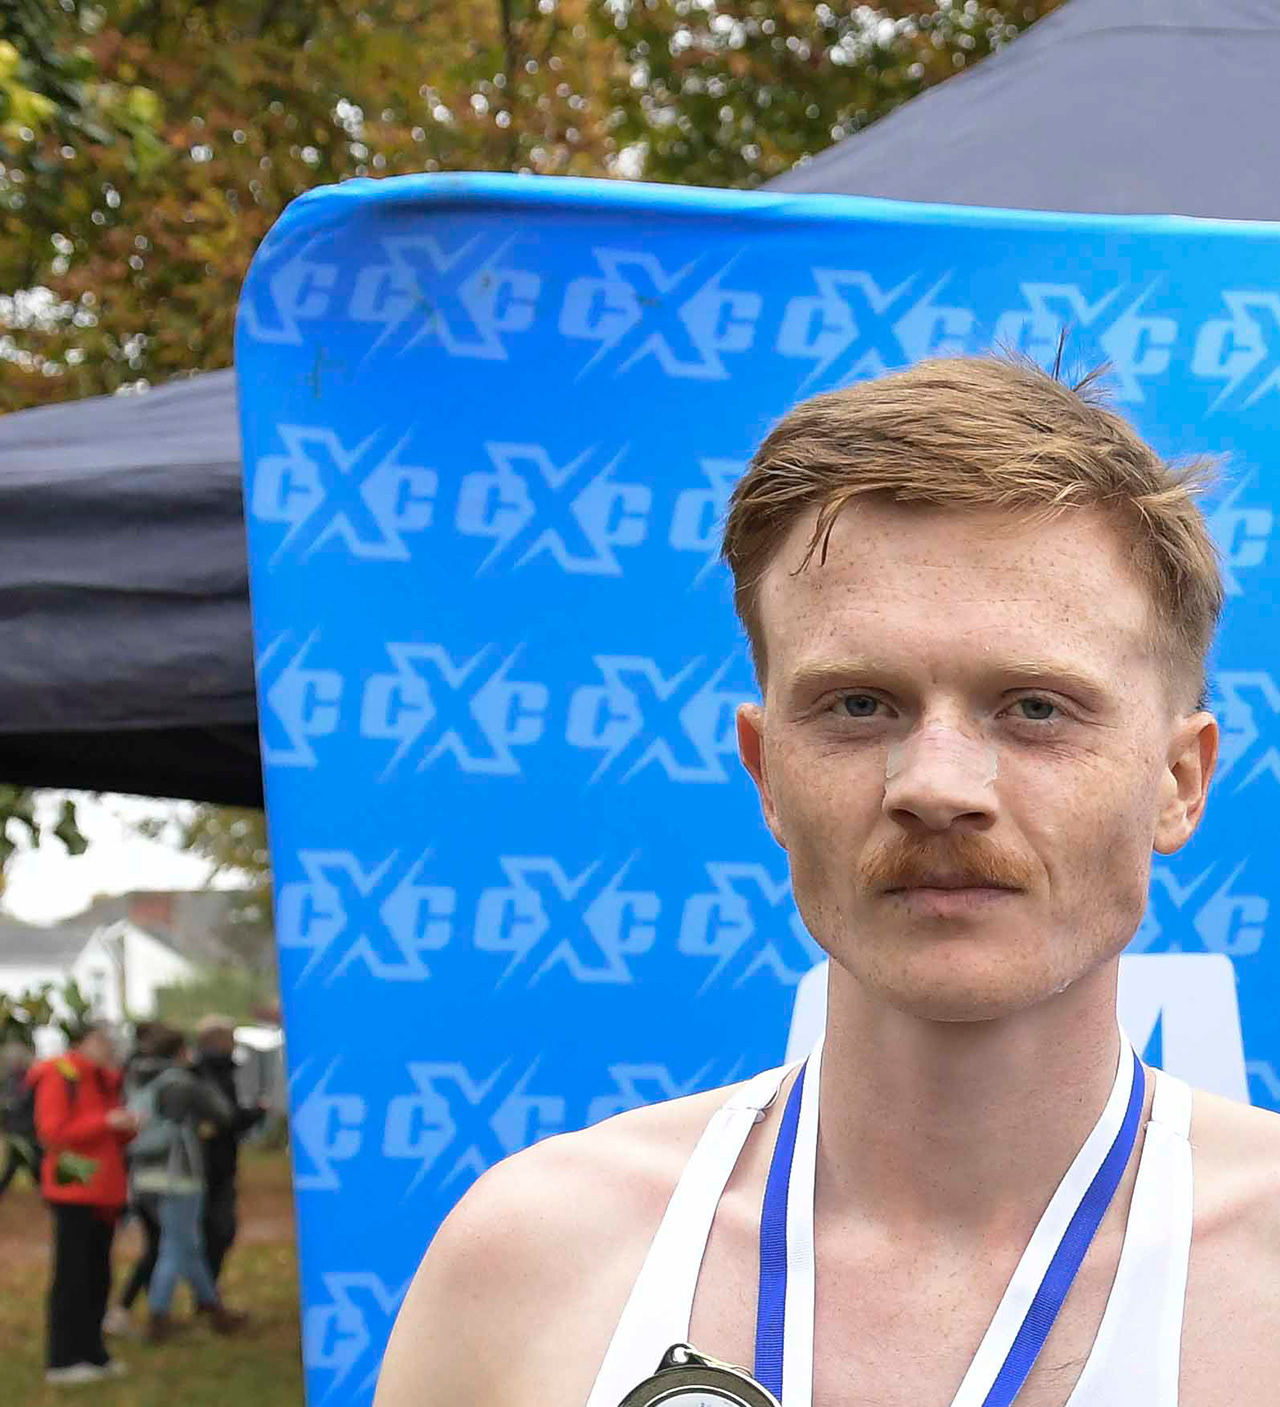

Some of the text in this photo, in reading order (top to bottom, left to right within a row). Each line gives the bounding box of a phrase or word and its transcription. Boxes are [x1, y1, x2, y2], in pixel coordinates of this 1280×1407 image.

[349, 236, 536, 359] CXC
[559, 249, 762, 378] CXC
[253, 425, 436, 558] CXC
[457, 444, 650, 574] CXC
[361, 643, 550, 773] CXC
[279, 851, 455, 980] CXC
[474, 857, 662, 983] CXC
